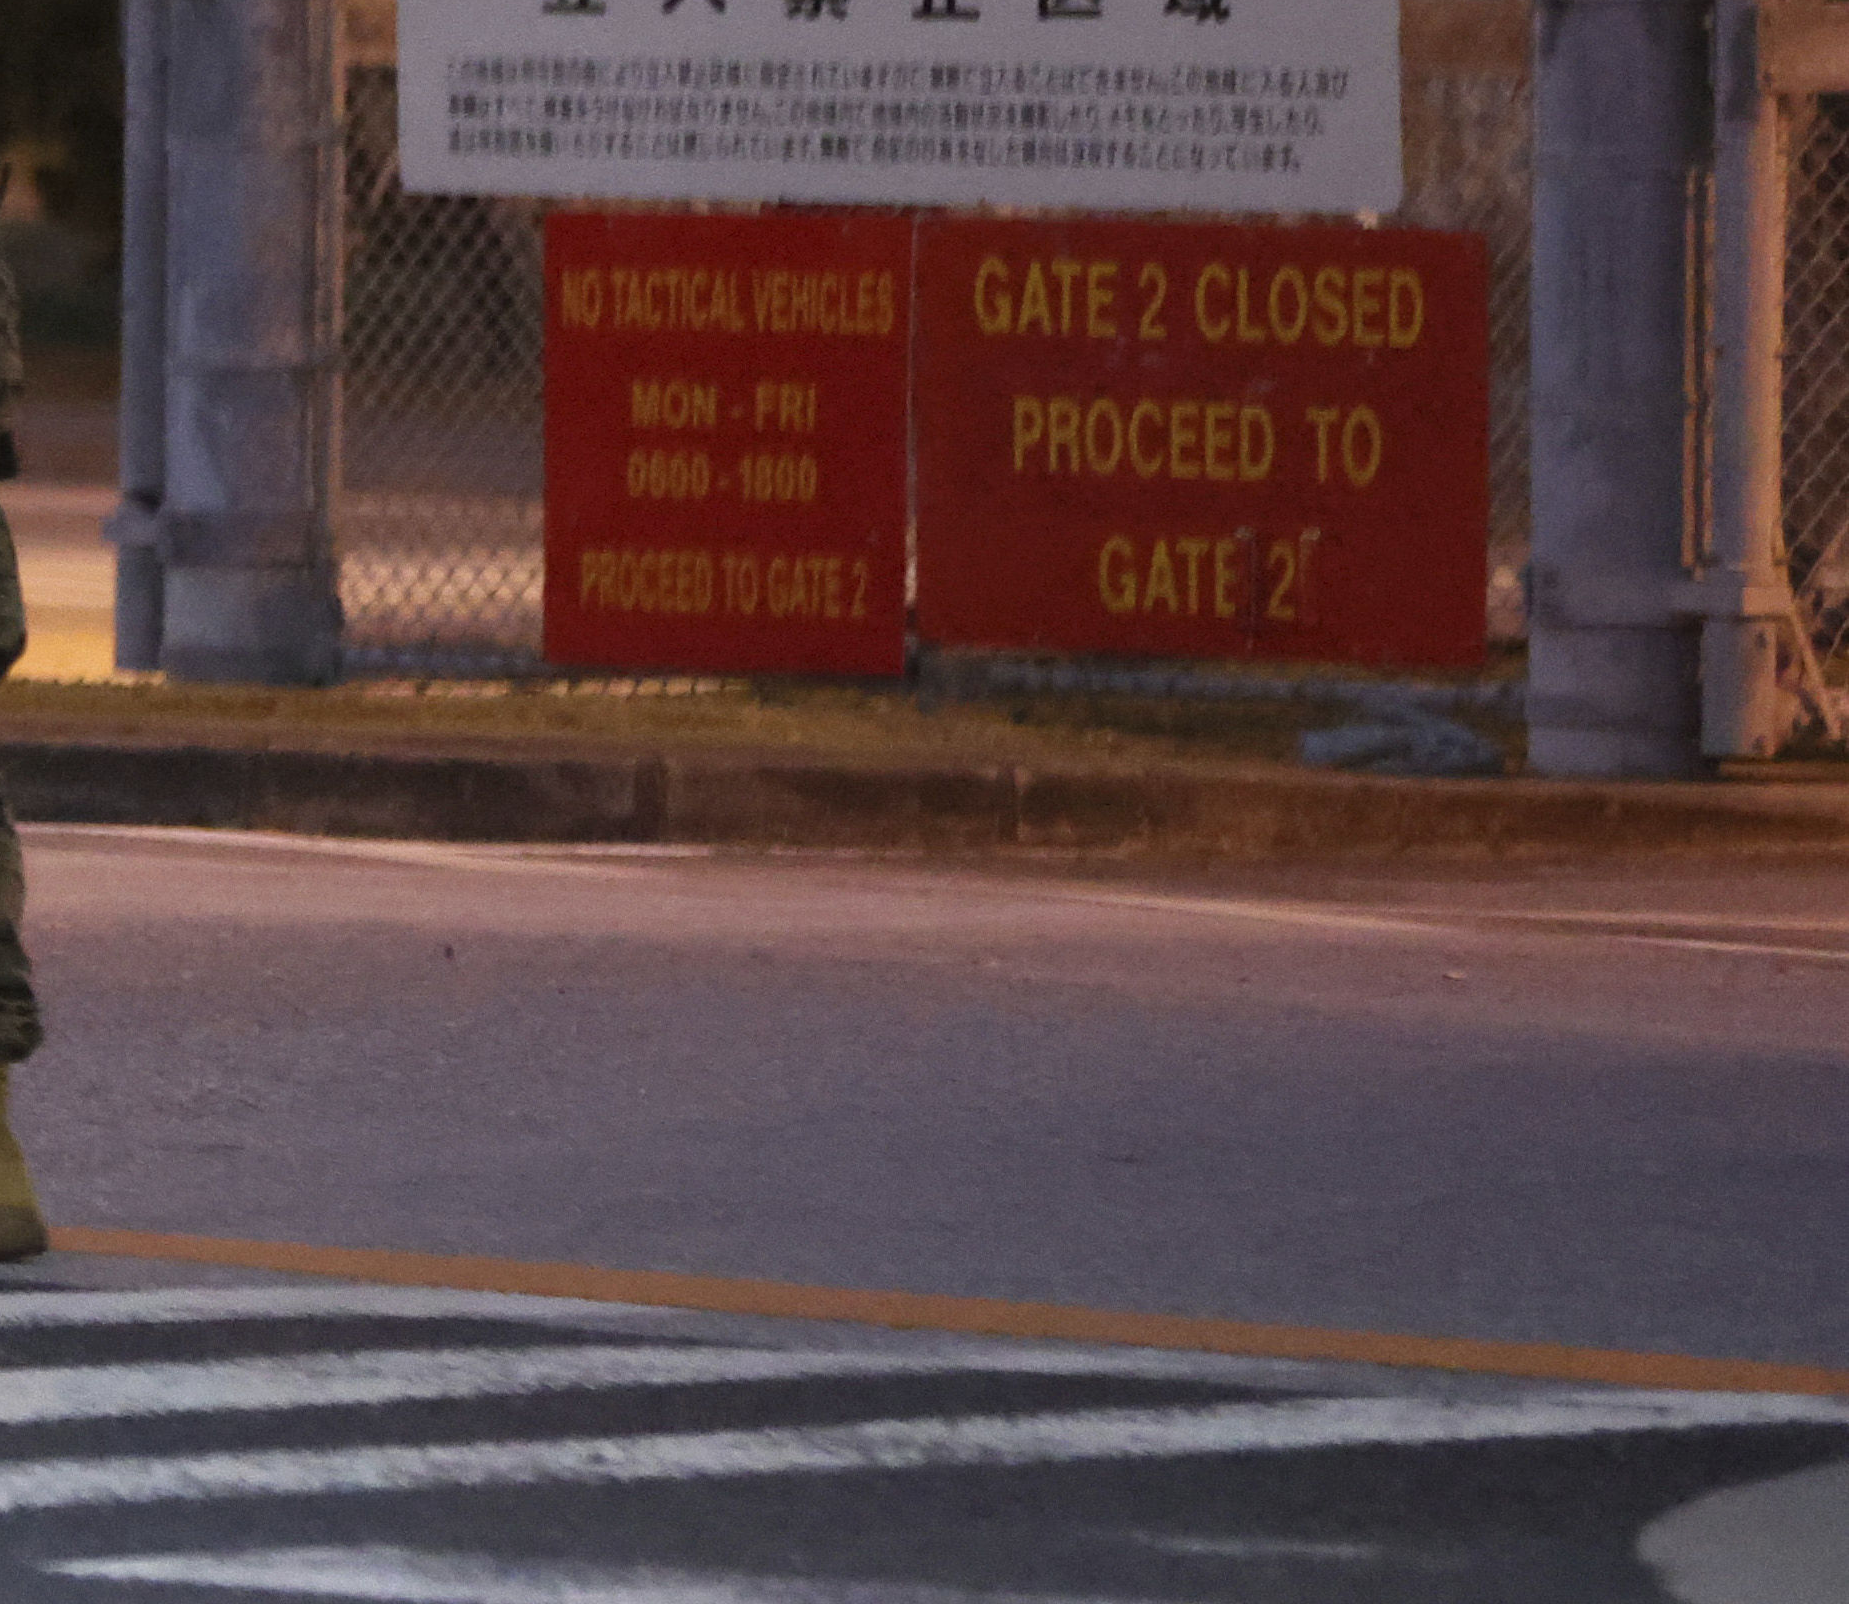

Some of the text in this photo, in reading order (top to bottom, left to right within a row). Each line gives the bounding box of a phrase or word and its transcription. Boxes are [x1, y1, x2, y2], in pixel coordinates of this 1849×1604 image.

[561, 268, 894, 334] NO TACTICAL VEHICLES
[975, 258, 1424, 348] GATE 2 CLOSED
[631, 379, 718, 429] MON
[755, 381, 816, 431] FRI
[1013, 397, 1382, 486] PROCEED TO
[581, 549, 868, 618] PROCEED TO GATE 2
[1101, 534, 1296, 620] GATE 2
